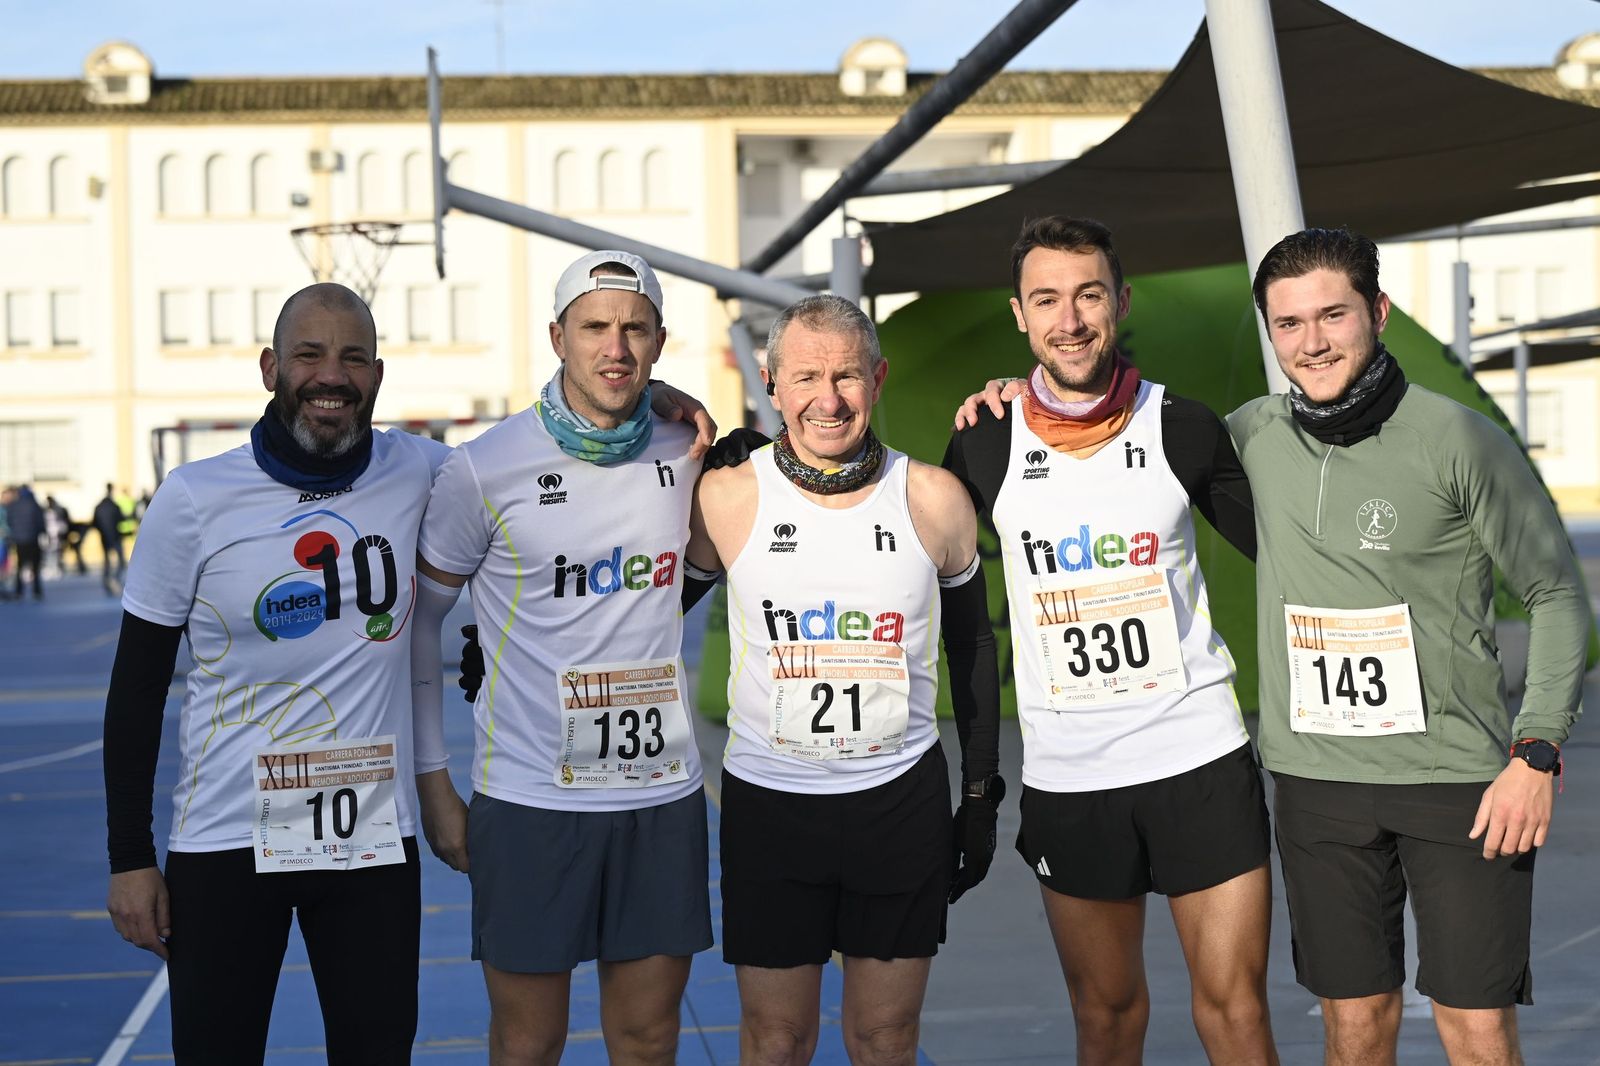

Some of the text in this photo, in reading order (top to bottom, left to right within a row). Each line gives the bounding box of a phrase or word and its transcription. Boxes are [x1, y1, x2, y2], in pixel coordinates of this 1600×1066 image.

[539, 491, 567, 500] SPORTING
[1021, 524, 1159, 575] indea
[306, 534, 398, 621] 10
[554, 546, 678, 598] indea
[266, 594, 321, 615] indea
[1036, 589, 1080, 626] XLII
[1082, 588, 1162, 607] SANTISIMA TRINIDAD TRINITARIOS
[264, 608, 325, 629] 2014-2024
[762, 599, 904, 643] indea
[1291, 615, 1326, 650] XLII
[773, 645, 817, 679] XLII
[1063, 617, 1150, 678] 330
[565, 673, 612, 709] XLII
[624, 668, 665, 680] CARRERA POPULAR
[1312, 655, 1388, 706] 143
[811, 682, 861, 734] 21
[594, 707, 665, 760] 133
[262, 753, 311, 790] XLII
[314, 759, 391, 772] SANTISIMA TRINIDAD TRINITARIOS
[325, 746, 378, 760] CARRERA POPULAR
[306, 788, 358, 841] 10
